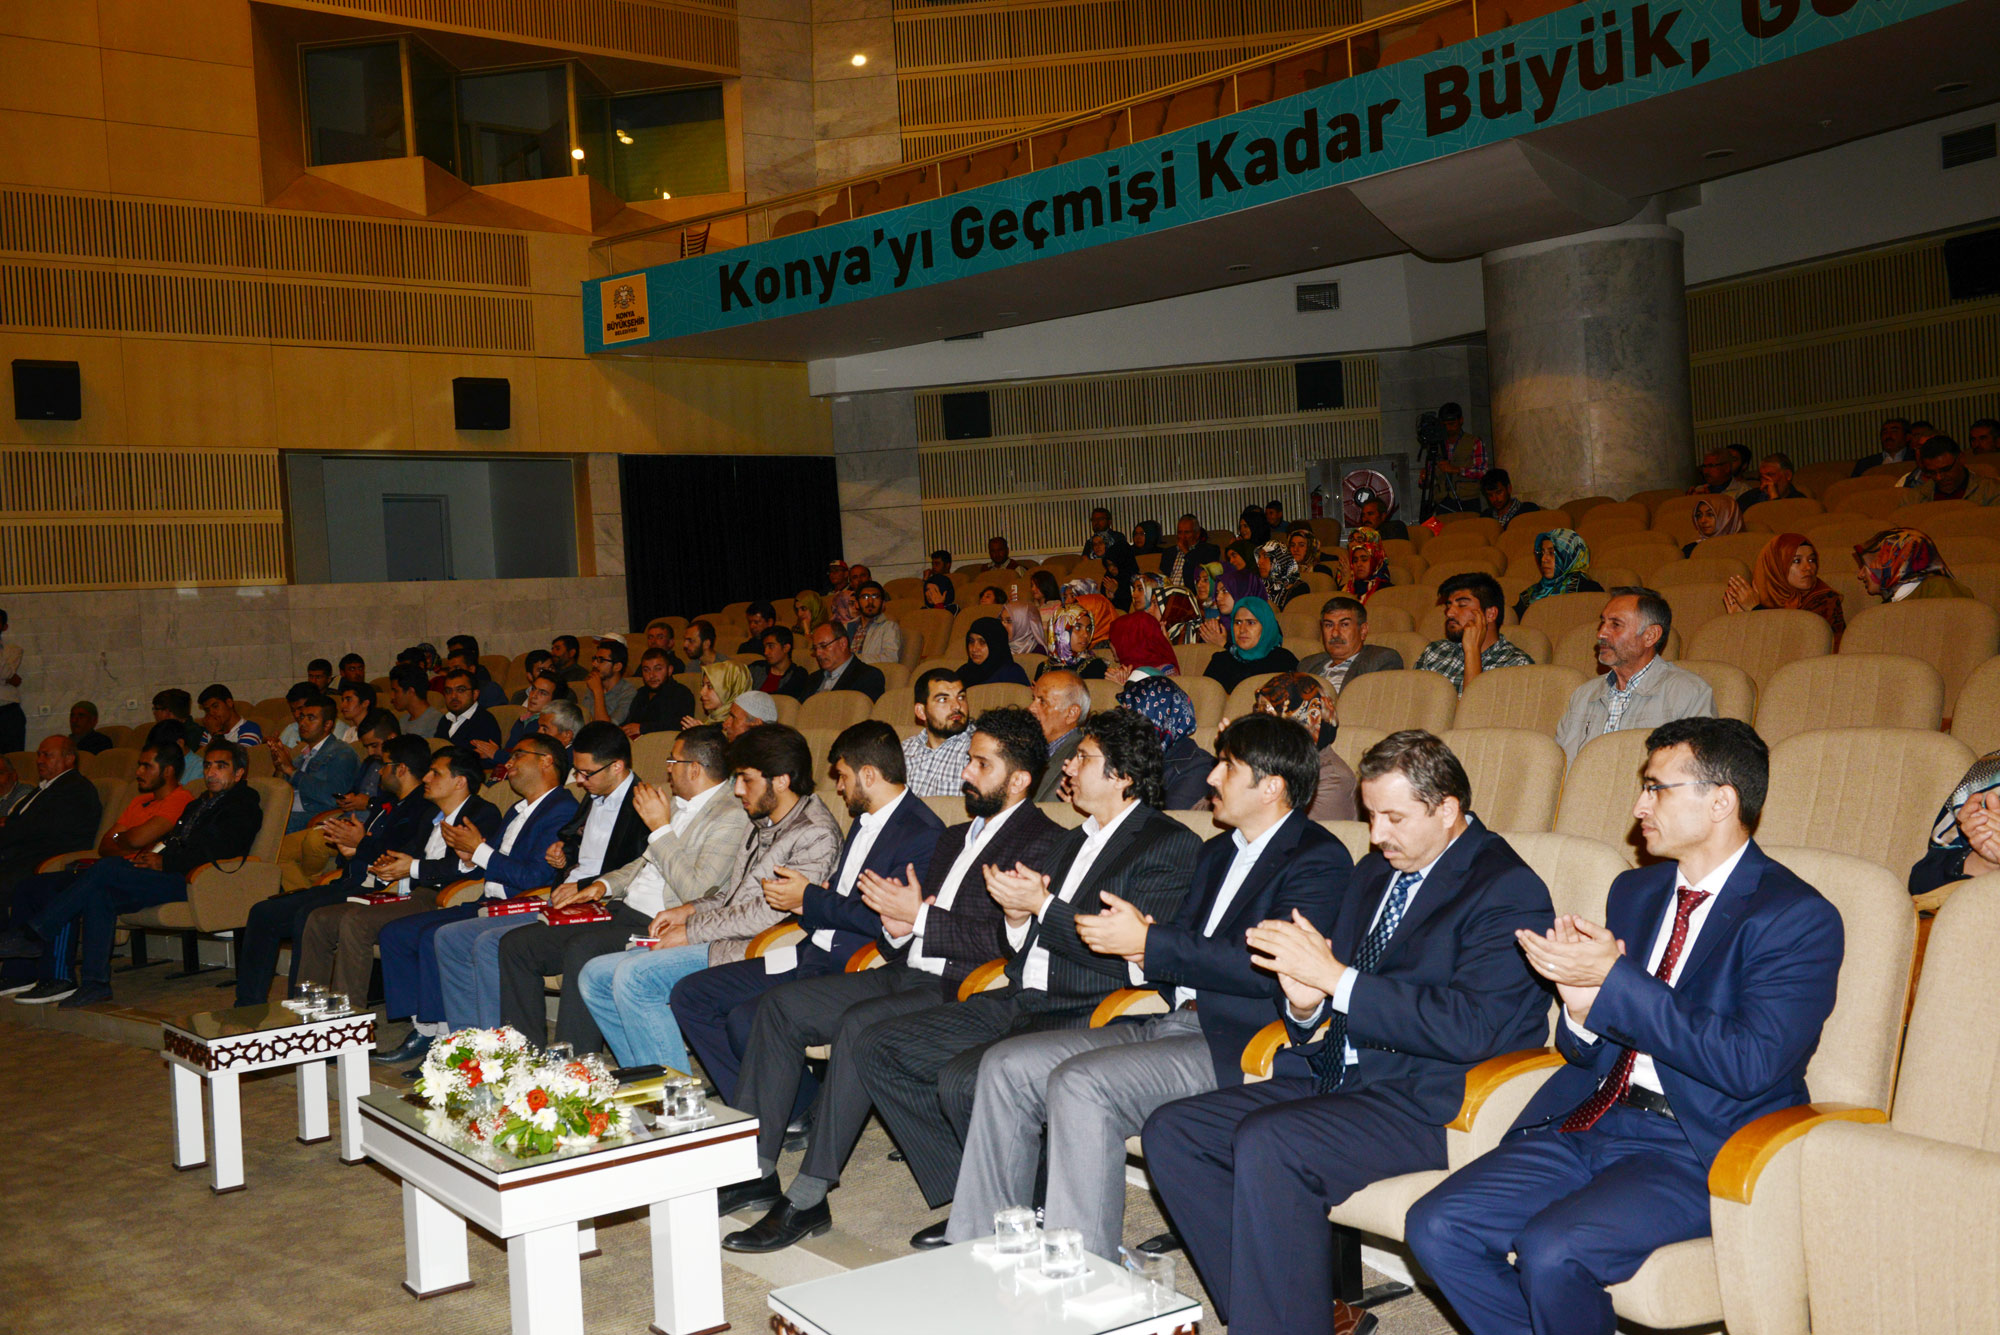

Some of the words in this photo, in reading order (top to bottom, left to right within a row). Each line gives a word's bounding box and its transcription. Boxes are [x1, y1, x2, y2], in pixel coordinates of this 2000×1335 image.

[719, 228, 934, 312] Konya'yı
[950, 150, 1178, 260] Geçmişi
[1197, 98, 1400, 200] Kadar
[1424, 2, 1710, 138] Büyük,
[615, 310, 635, 320] KONYA
[606, 316, 645, 331] BÜYÜKŞEHİR
